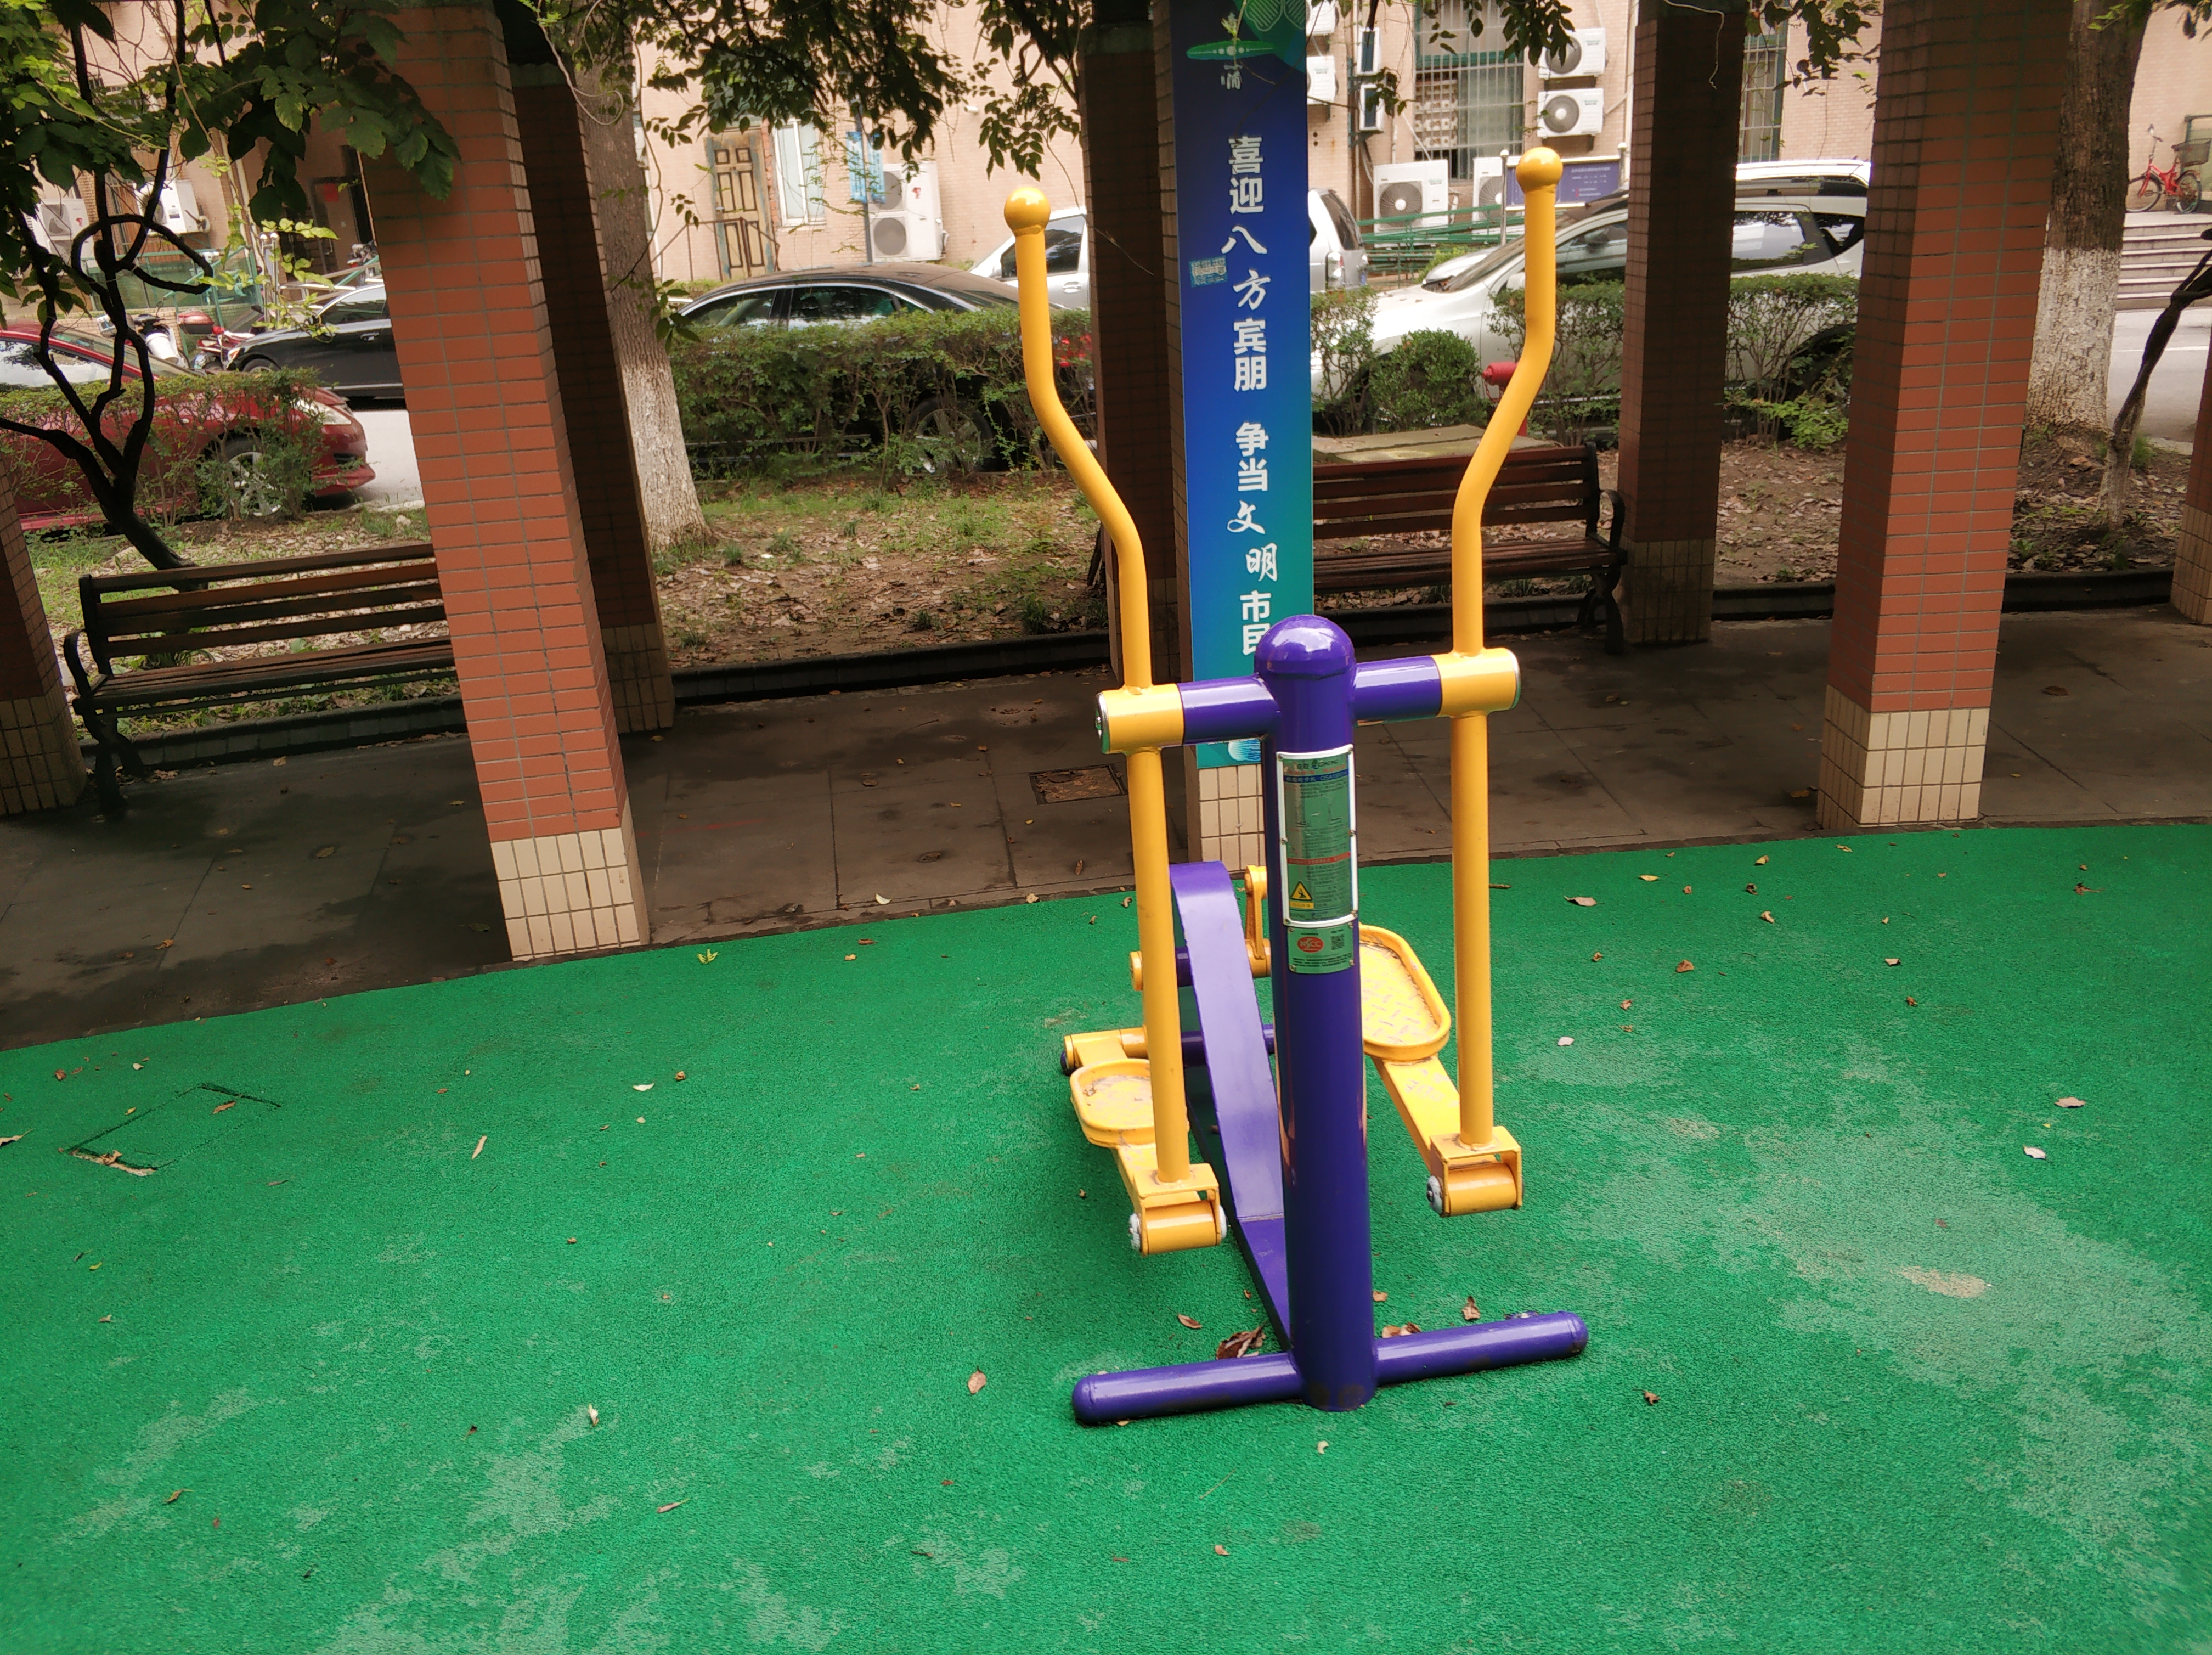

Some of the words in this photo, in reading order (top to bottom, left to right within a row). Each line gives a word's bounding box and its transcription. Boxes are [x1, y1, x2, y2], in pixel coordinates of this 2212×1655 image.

[1221, 136, 1271, 391] 喜迎八方宾朋
